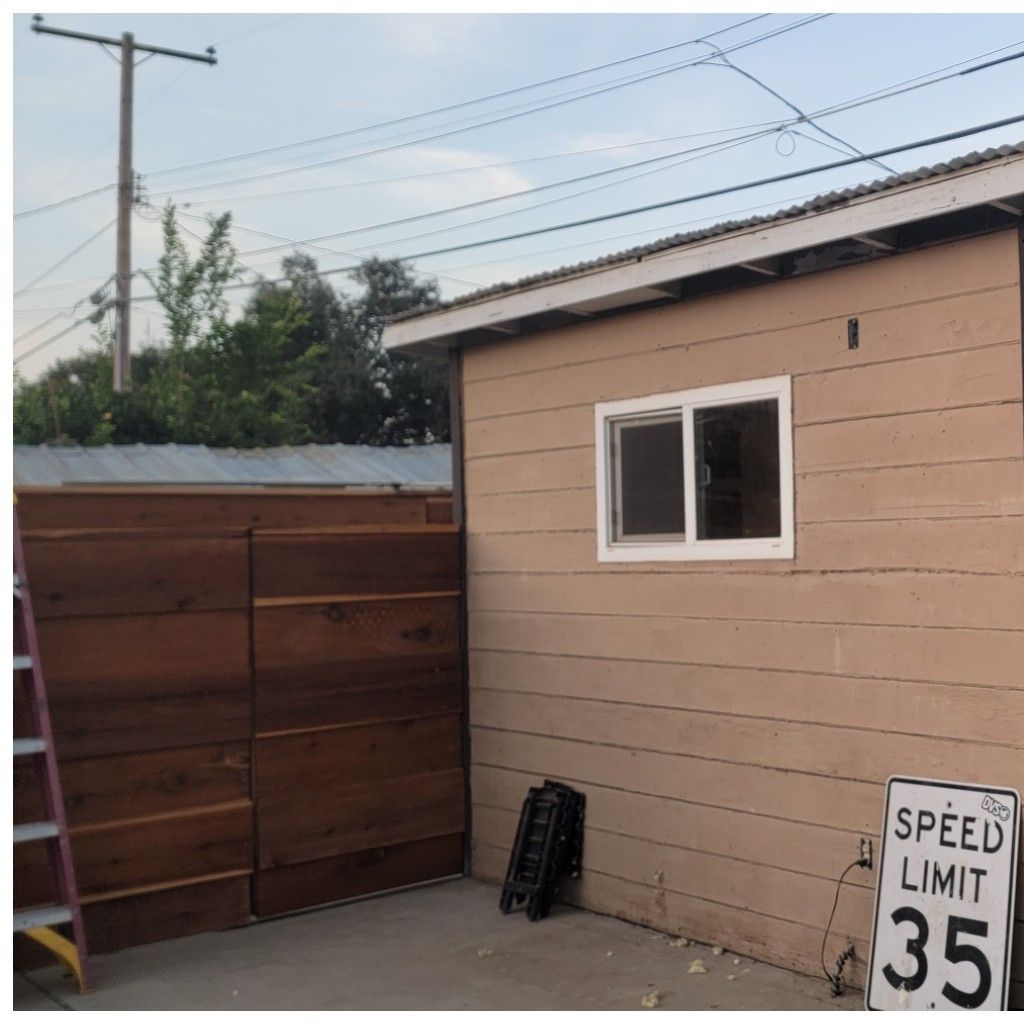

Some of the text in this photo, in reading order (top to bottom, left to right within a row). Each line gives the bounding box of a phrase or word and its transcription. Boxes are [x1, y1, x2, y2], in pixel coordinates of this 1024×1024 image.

[894, 807, 1004, 854] SPEED
[901, 856, 988, 904] LIMIT
[882, 906, 992, 1010] 35
